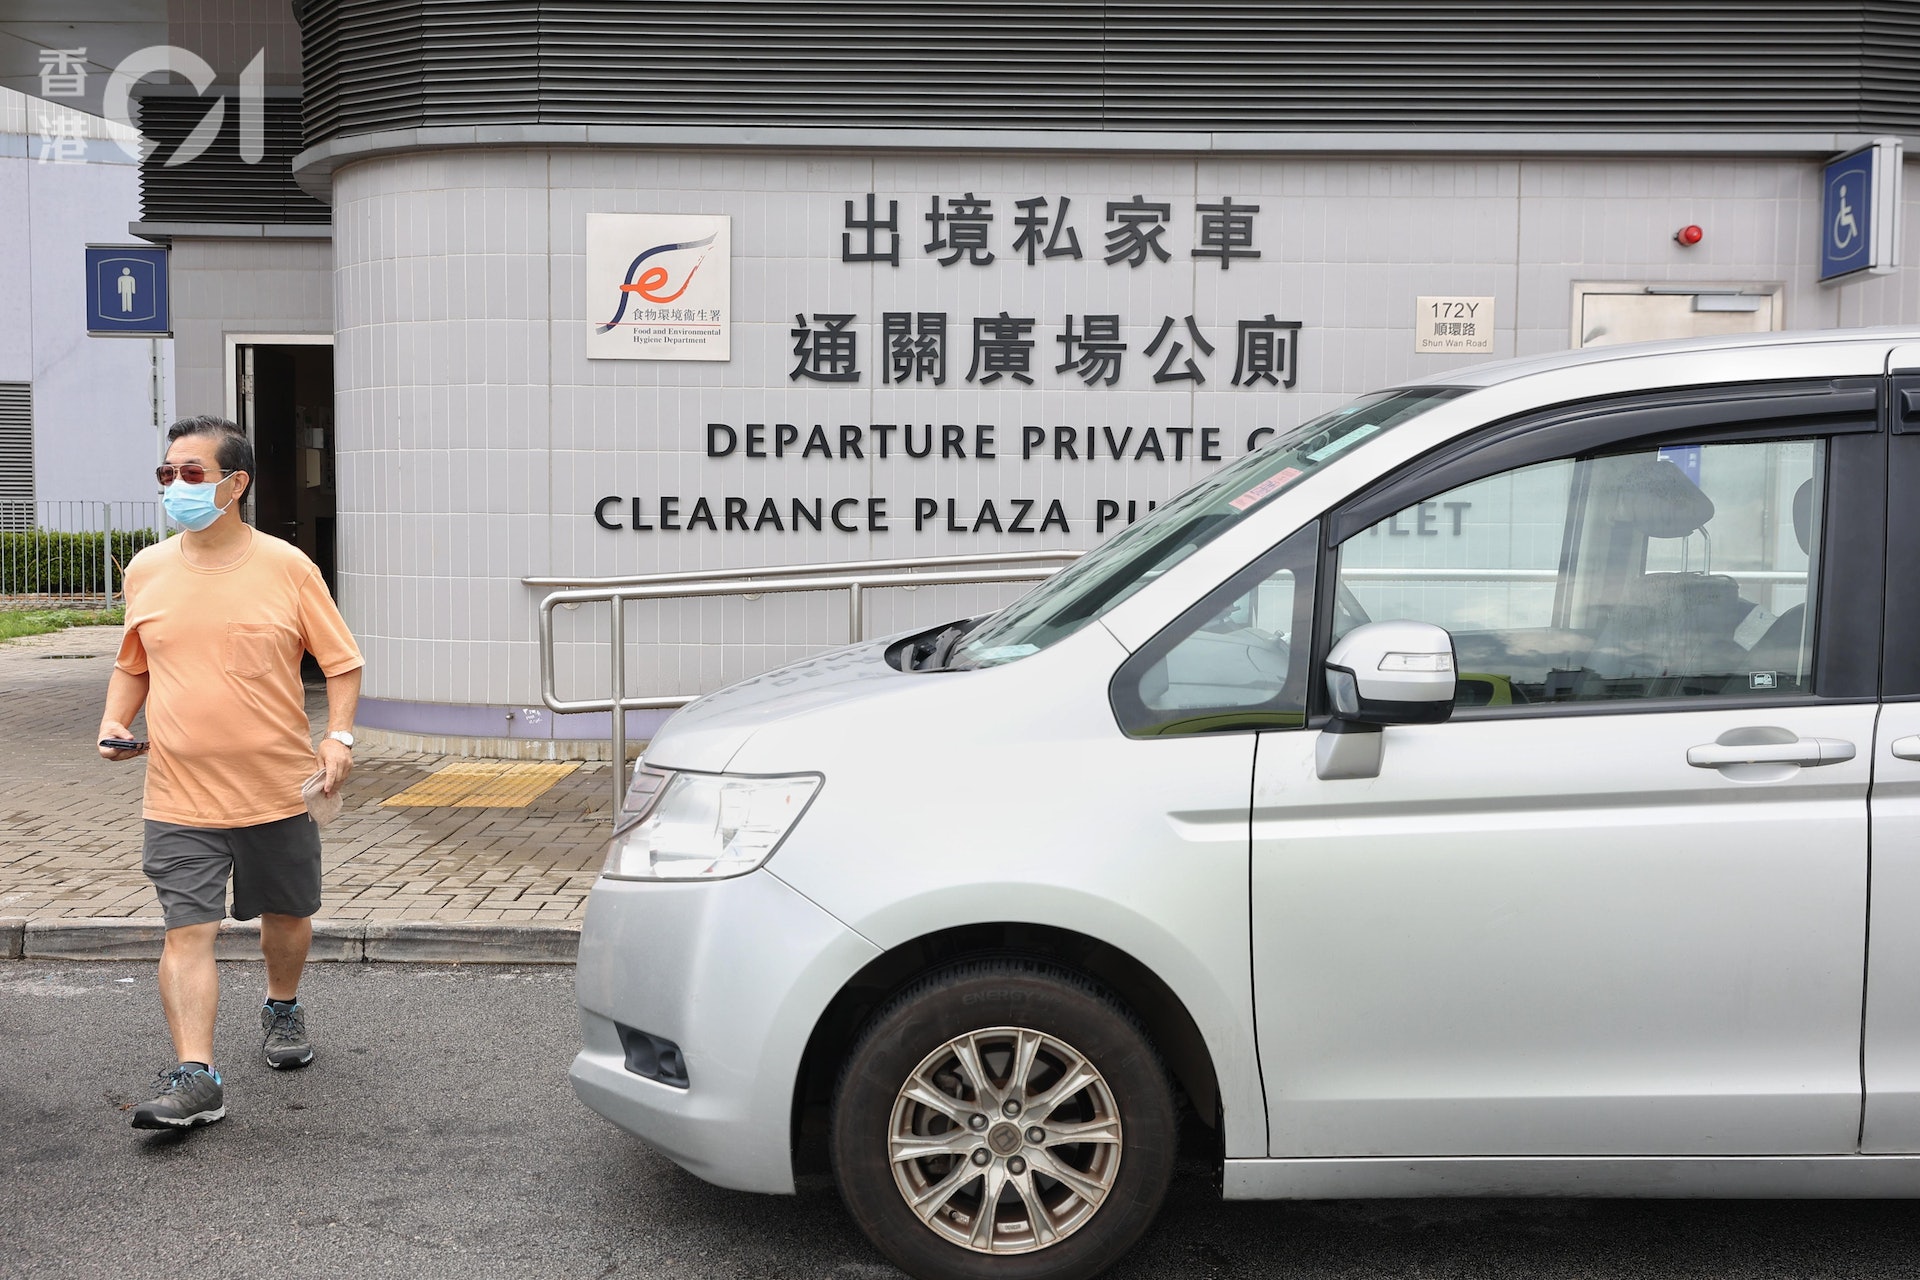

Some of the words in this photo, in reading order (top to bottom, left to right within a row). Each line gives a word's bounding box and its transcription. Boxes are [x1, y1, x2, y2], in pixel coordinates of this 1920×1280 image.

[842, 192, 1261, 270] 出境私家車
[1431, 302, 1479, 318] 172Y
[633, 327, 651, 335] Food
[668, 328, 721, 336] Environmental
[1433, 322, 1476, 336] 順環路
[633, 335, 662, 344] Hygiene
[664, 336, 706, 345] Department
[1422, 338, 1443, 347] Shun
[1445, 339, 1464, 347] Wan
[1466, 339, 1488, 347] Road
[789, 311, 1303, 390] 通關廣場公廁
[707, 423, 996, 460] DEPARTURE
[1022, 426, 1222, 462] PRIVATE
[594, 495, 889, 533] CLEARANCE
[915, 497, 1071, 534] PLAZA
[962, 988, 1035, 1006] ENERGY
